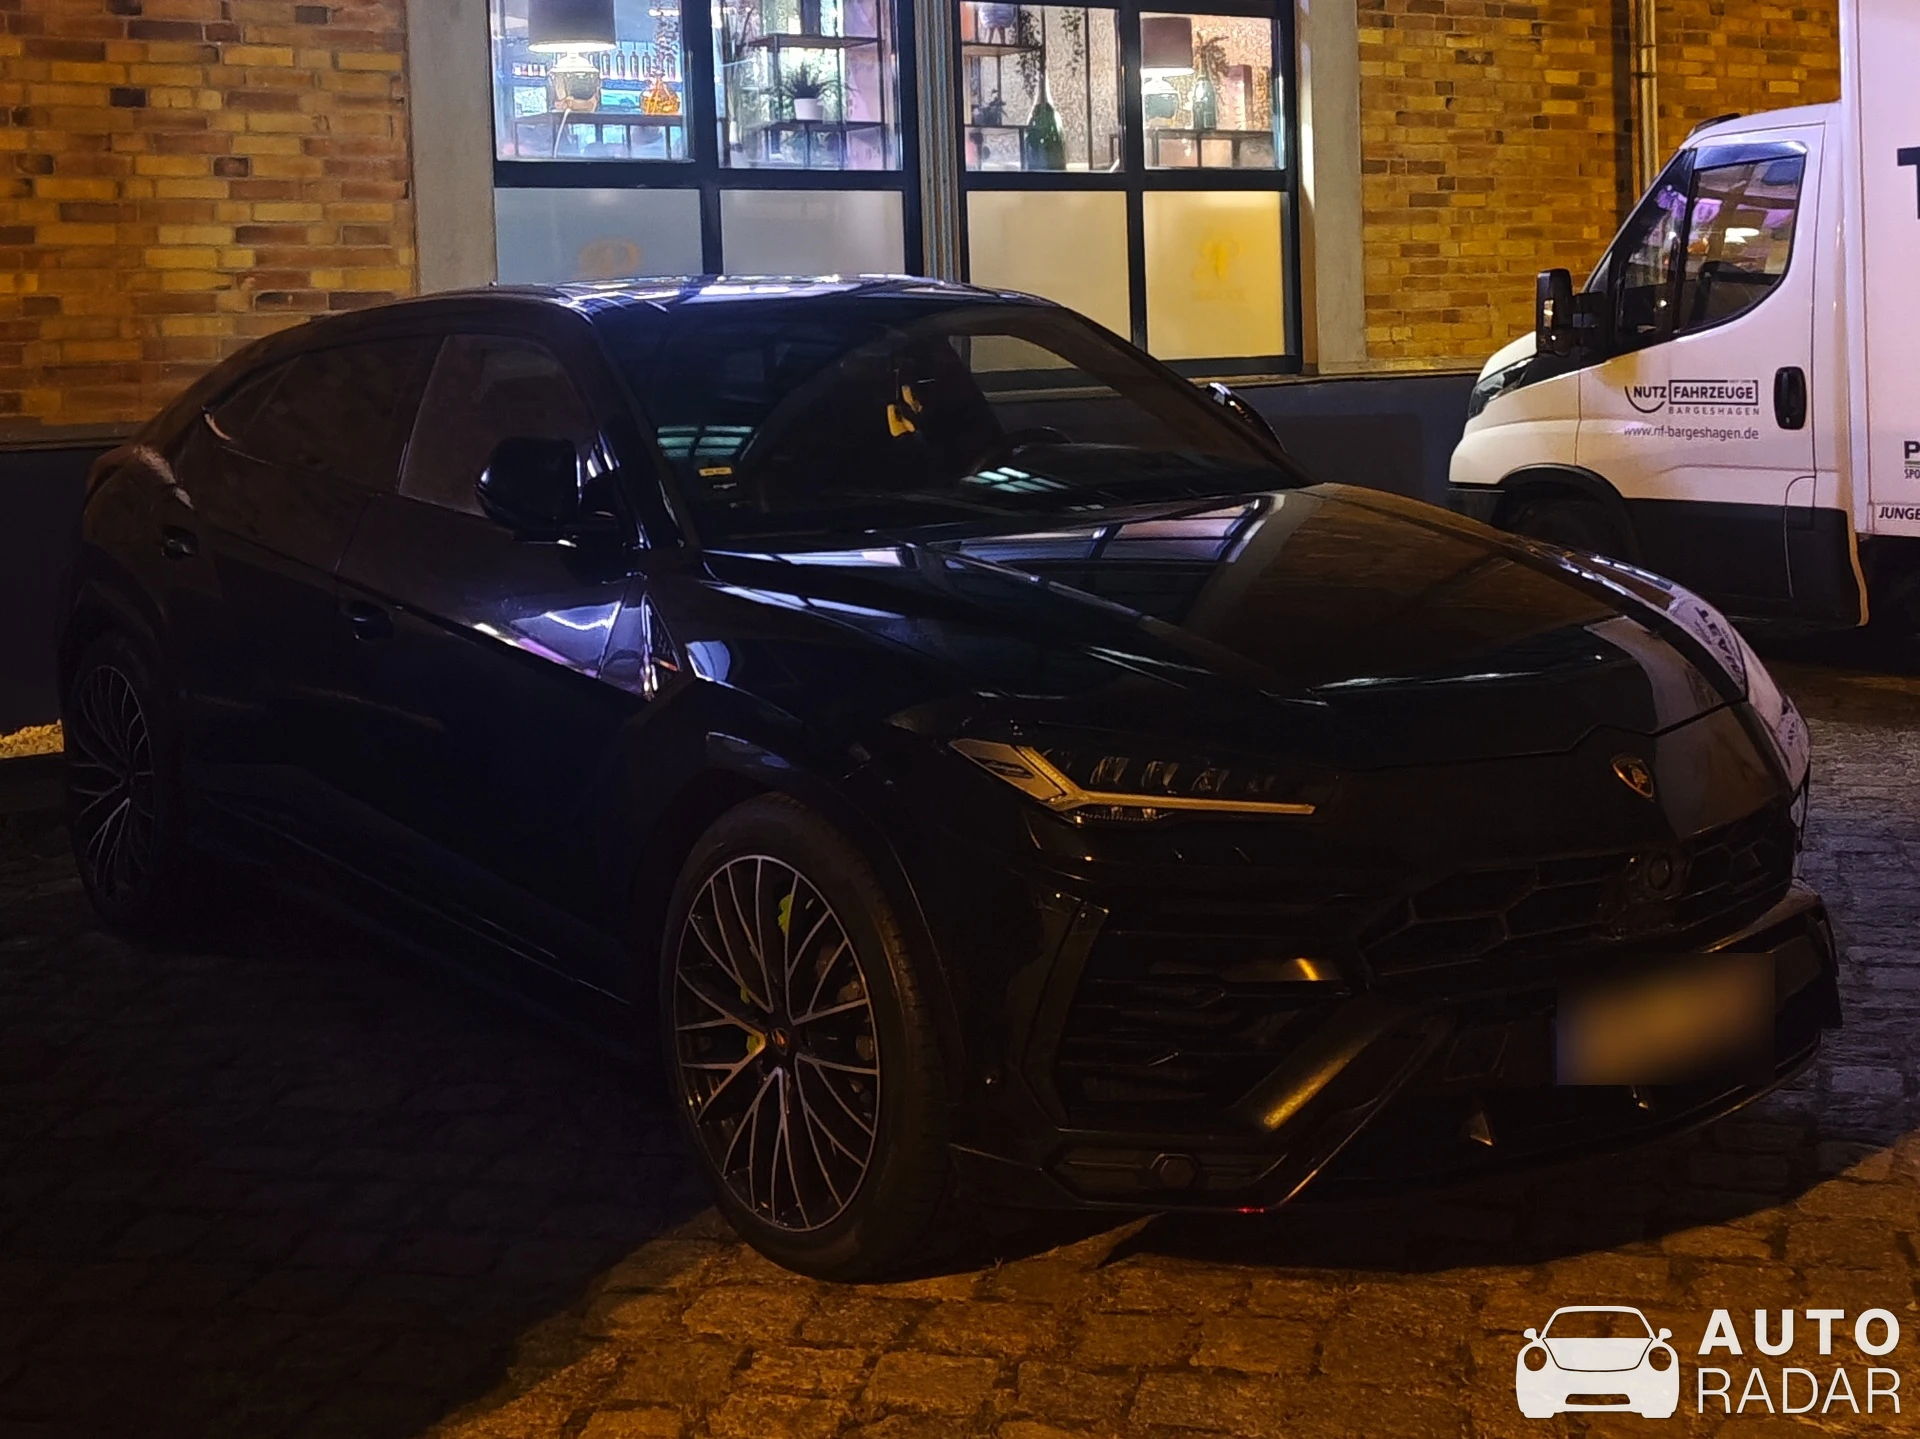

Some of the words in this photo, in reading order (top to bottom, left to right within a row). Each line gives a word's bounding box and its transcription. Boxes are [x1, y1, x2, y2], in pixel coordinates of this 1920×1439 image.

[1633, 386, 1667, 398] NUTZ
[1673, 386, 1753, 399] FAHRZEUGE
[1668, 406, 1760, 416] BARGESHAGEN
[1624, 424, 1759, 441] www.nf-bargeshagen.de
